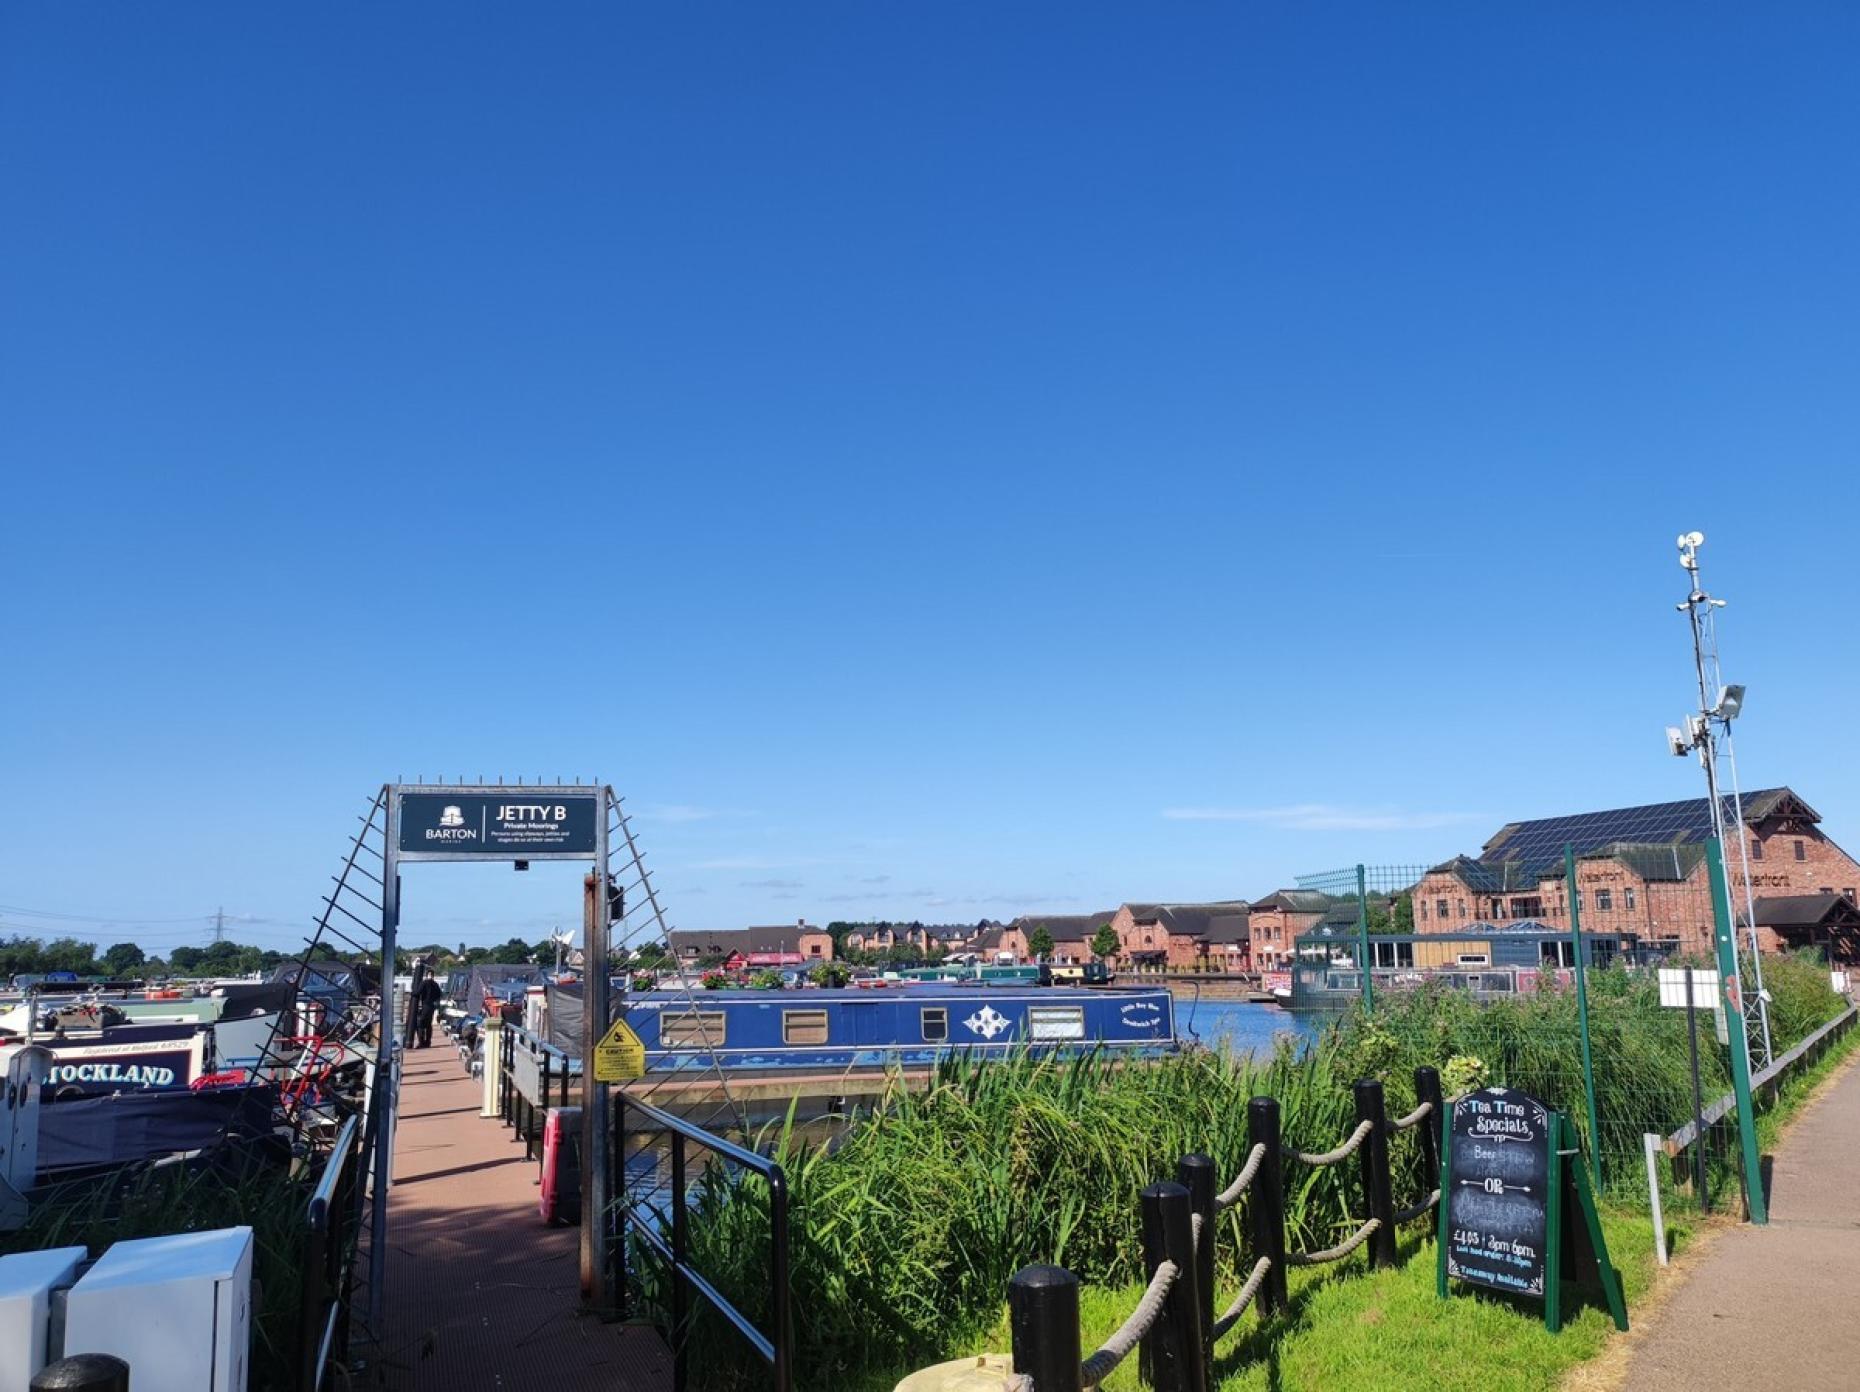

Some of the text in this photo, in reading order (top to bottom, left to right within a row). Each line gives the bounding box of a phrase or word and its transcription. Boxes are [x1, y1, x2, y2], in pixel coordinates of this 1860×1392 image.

[496, 805, 567, 821] JETTY B
[425, 828, 477, 840] BARTON
[528, 822, 559, 831] Moorings
[42, 1063, 175, 1087] TOCKLAND
[1468, 1100, 1525, 1117] Tea Time
[1476, 1115, 1529, 1134] Specials
[1484, 1177, 1504, 1195] OR
